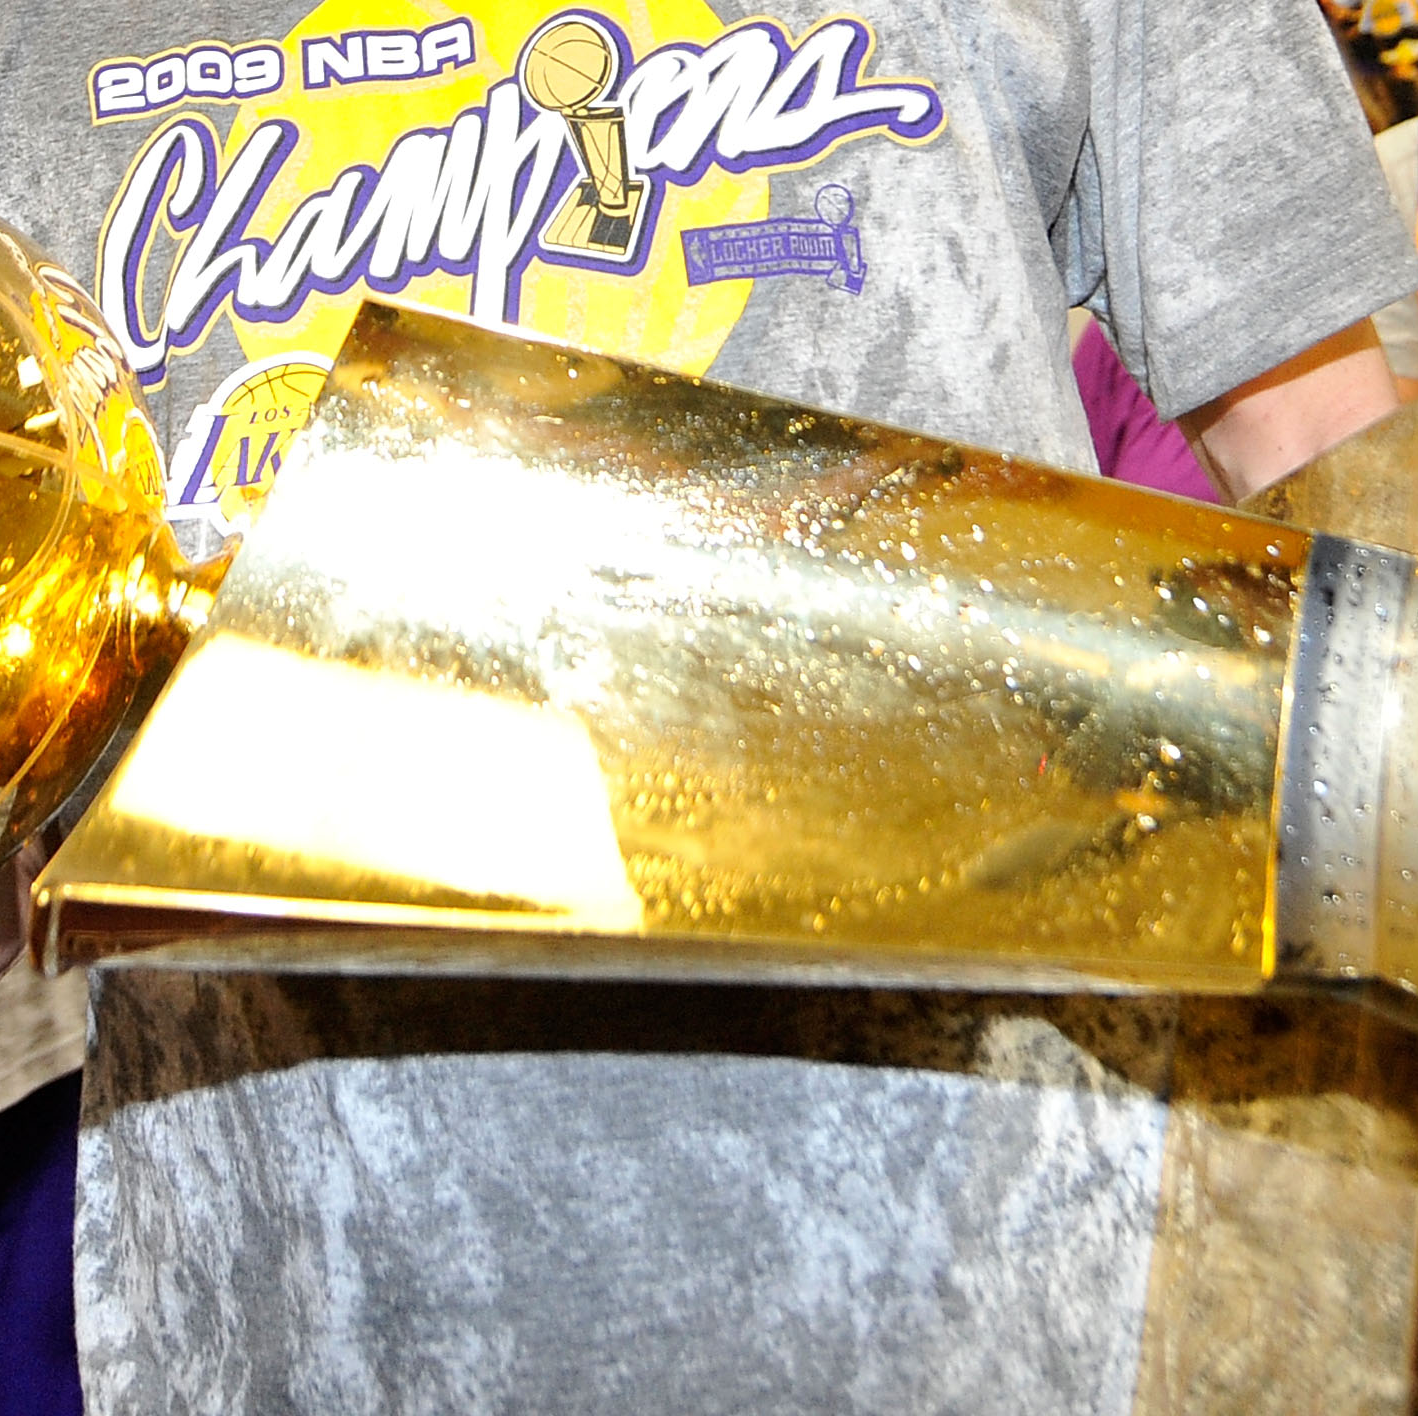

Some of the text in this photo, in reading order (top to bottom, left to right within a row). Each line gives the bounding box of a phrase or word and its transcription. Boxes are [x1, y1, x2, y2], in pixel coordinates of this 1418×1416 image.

[95, 21, 474, 112] 2009 NBA
[711, 234, 837, 262] LOCKER ROOM
[249, 406, 291, 425] LOS
